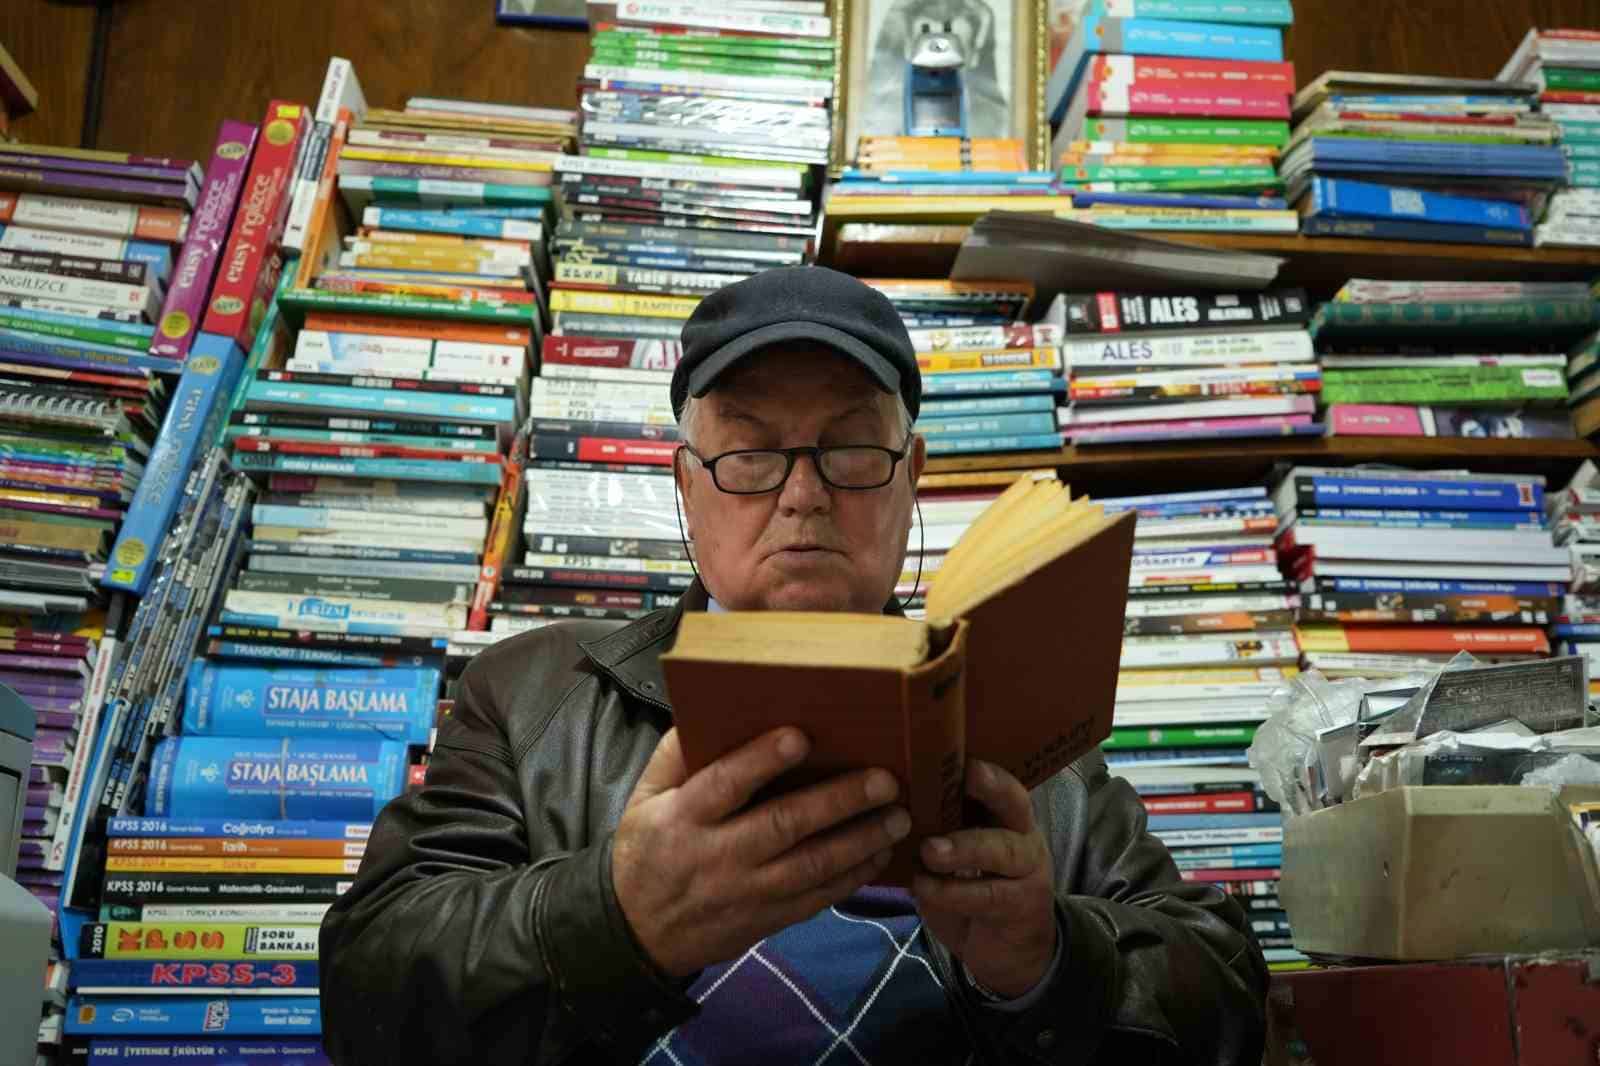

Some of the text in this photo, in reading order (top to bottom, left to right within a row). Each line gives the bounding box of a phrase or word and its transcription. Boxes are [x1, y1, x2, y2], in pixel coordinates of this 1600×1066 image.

[226, 239, 257, 284] easy
[1150, 296, 1200, 323] ALES
[1101, 343, 1153, 361] ALES
[268, 687, 407, 719] STAJA BAŞLAMA
[231, 763, 369, 785] STAJA BAŞLAMA
[112, 819, 134, 832] KPSS
[135, 818, 167, 833] 2016
[223, 822, 275, 836] Coğrafya
[112, 839, 134, 850] KPSS
[135, 839, 167, 851] 2016
[222, 840, 248, 852] Tarih
[106, 881, 134, 894] KPSS
[135, 881, 165, 894] 2016
[117, 927, 225, 952] KPSS
[261, 930, 295, 940] SORU
[259, 941, 316, 952] BANKASI
[151, 962, 297, 986] KPSS-3
